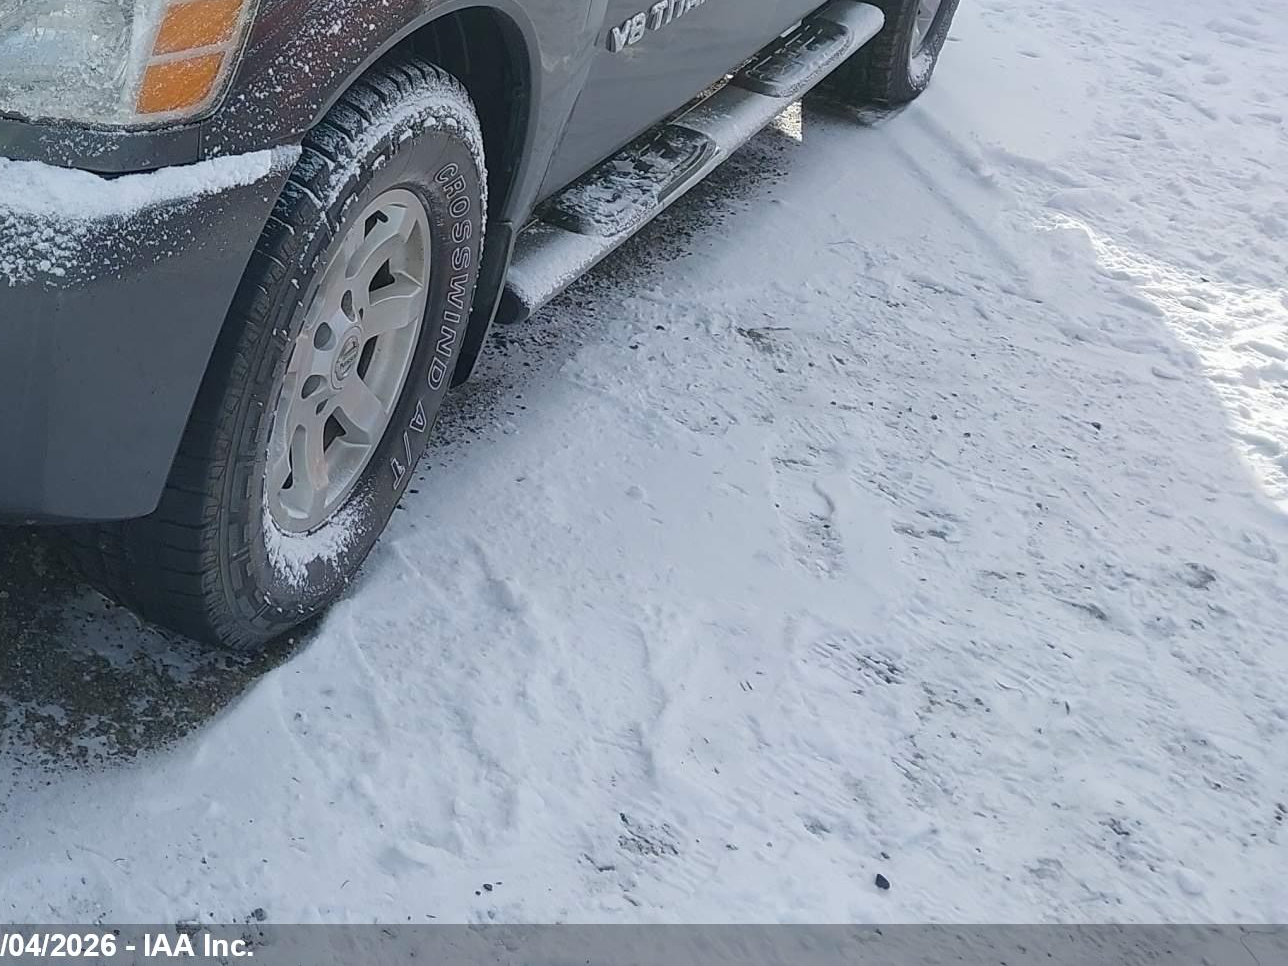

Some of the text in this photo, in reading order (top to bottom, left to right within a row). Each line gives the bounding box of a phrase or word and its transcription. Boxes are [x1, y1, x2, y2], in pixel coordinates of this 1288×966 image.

[606, 11, 647, 52] V8
[391, 162, 472, 490] CROSSWIND A/T
